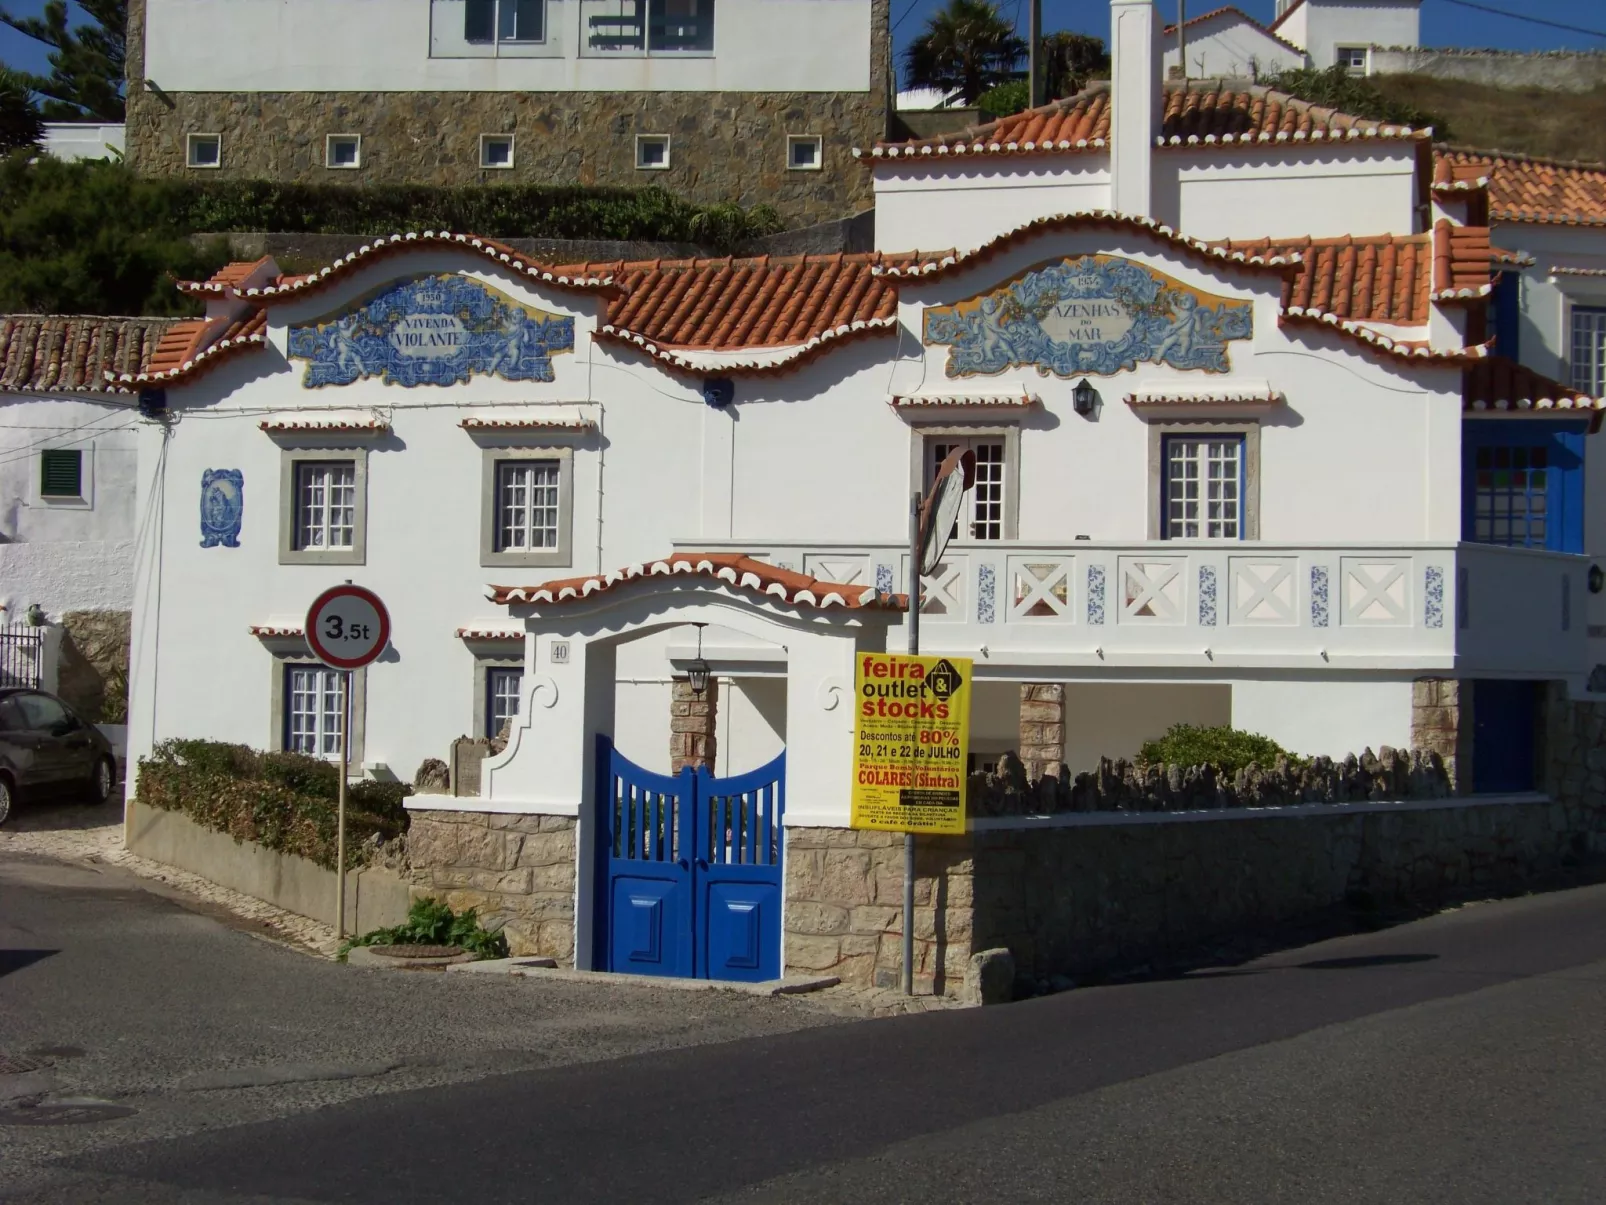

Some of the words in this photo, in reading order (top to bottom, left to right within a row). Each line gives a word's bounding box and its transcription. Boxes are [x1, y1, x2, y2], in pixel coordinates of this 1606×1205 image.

[422, 293, 441, 301] 1950
[1055, 304, 1120, 317] AZENHAS
[405, 318, 456, 328] VIVENDA
[395, 332, 461, 346] VIOLANTE
[1069, 328, 1101, 340] MAR
[325, 615, 370, 642] 3,5t
[553, 645, 567, 659] 40
[863, 657, 924, 679] feira
[862, 680, 927, 698] outlet
[862, 697, 949, 719] stocks
[861, 730, 902, 742] Descontos
[904, 732, 917, 742] até
[920, 730, 959, 746] 80%
[859, 744, 874, 758] 20,
[877, 745, 887, 757] 21
[891, 748, 897, 757] e
[900, 746, 911, 758] 22
[914, 747, 925, 758] de
[928, 747, 960, 759] JULHO
[860, 763, 888, 771] Parque
[858, 770, 912, 786] COLARES
[914, 773, 960, 788] (Sintra)
